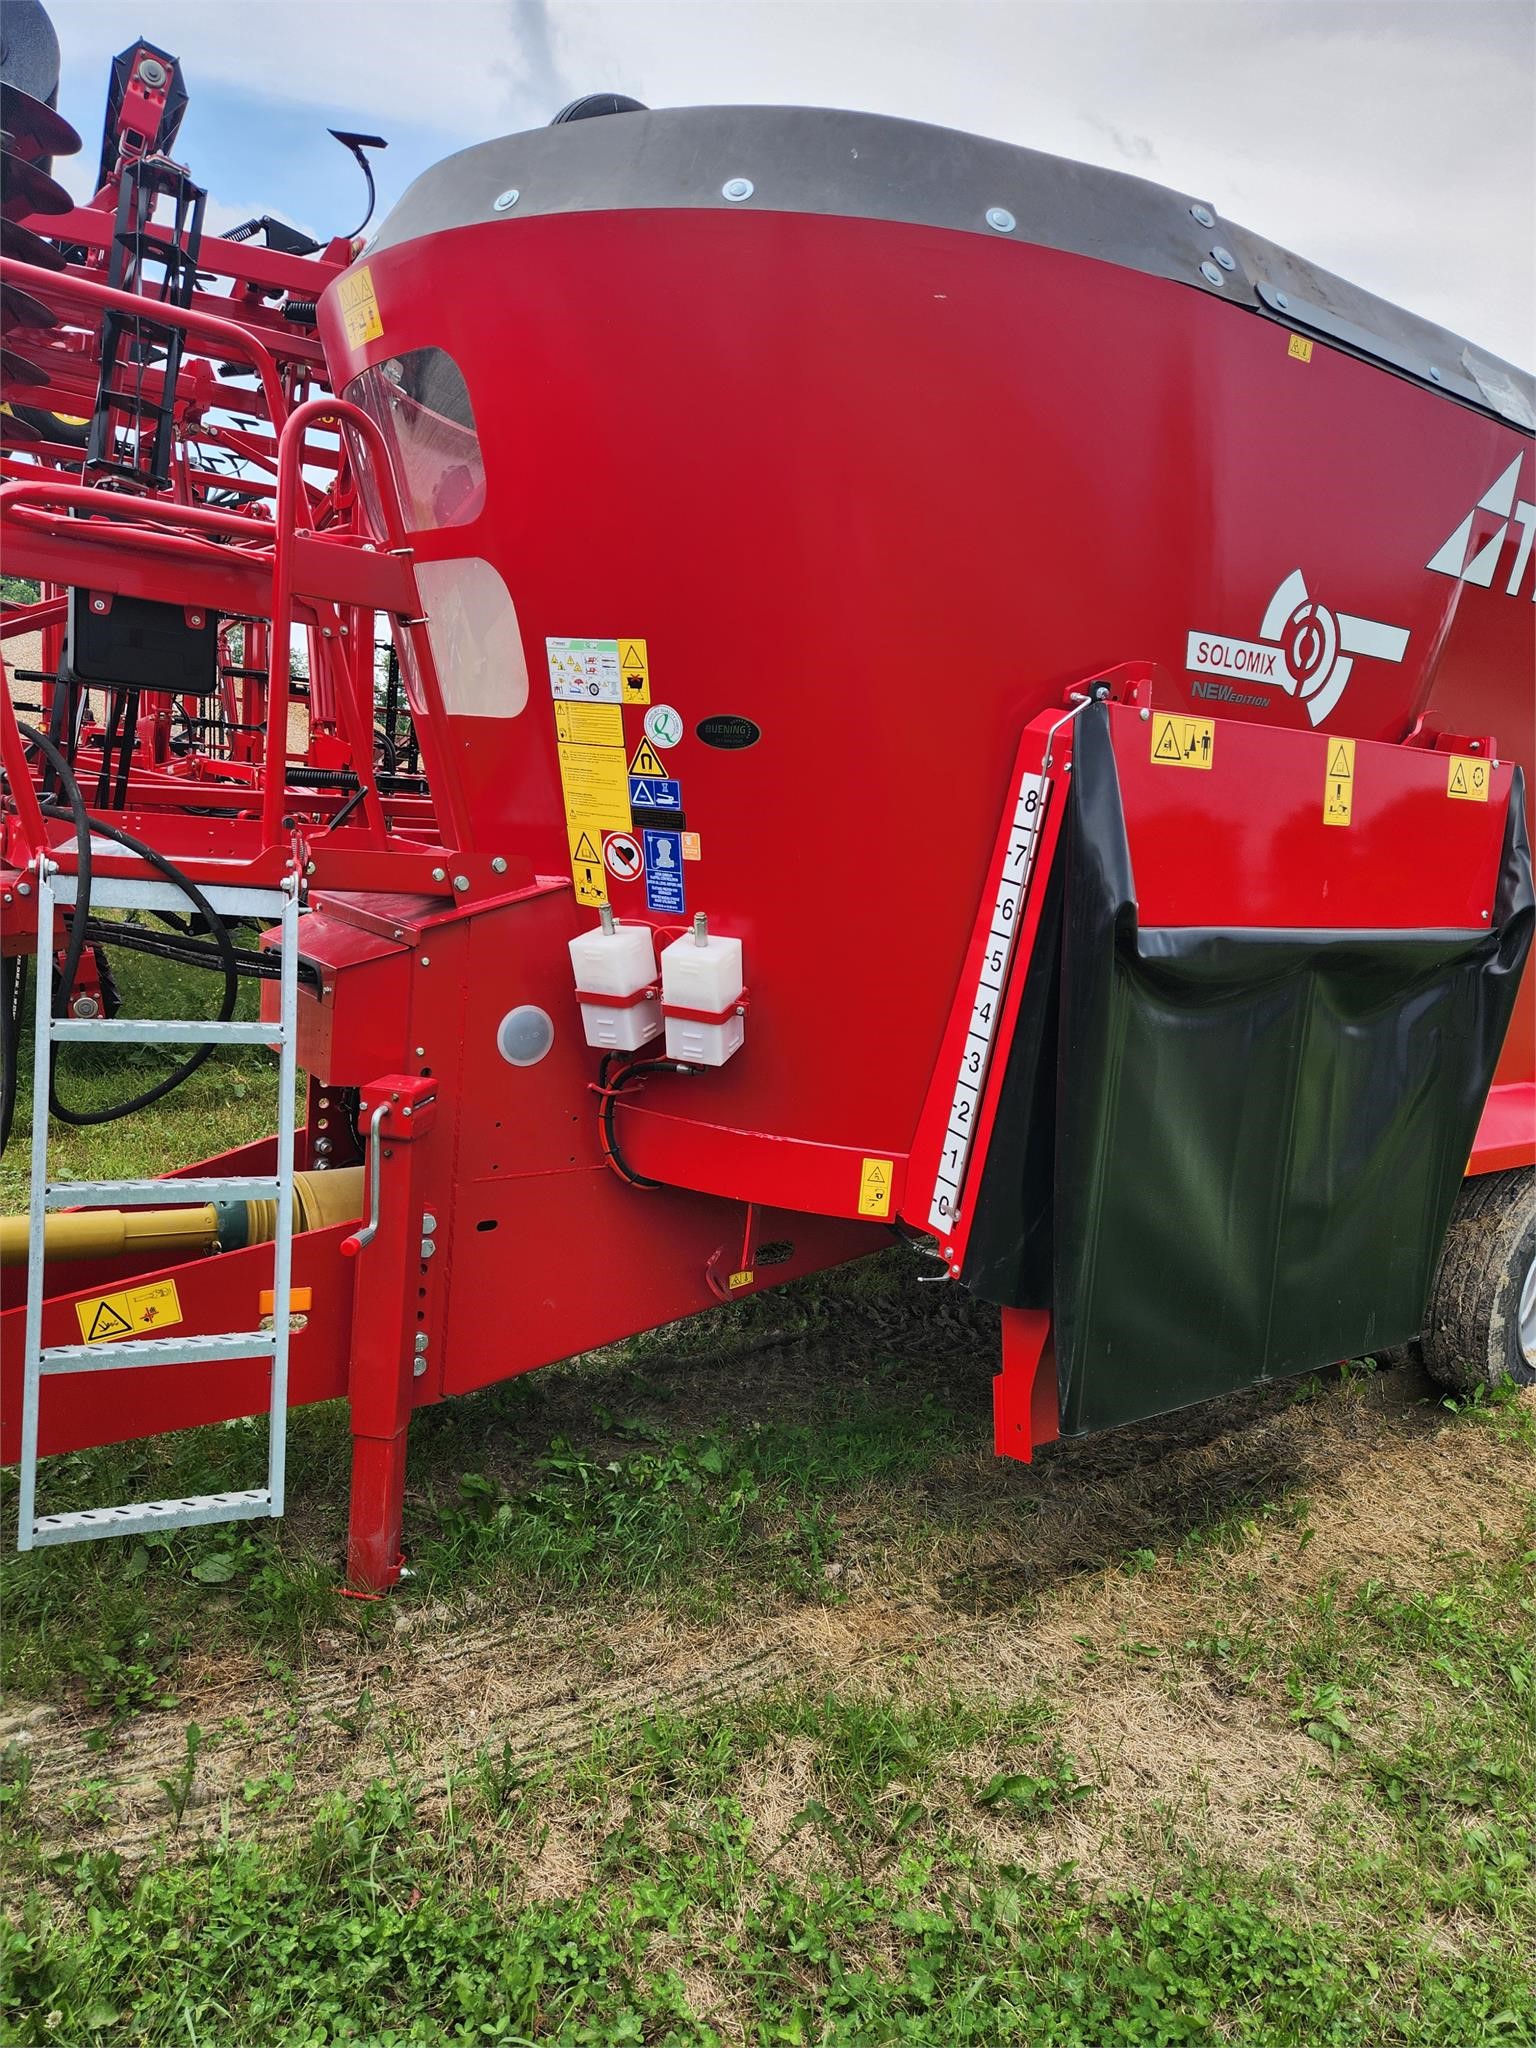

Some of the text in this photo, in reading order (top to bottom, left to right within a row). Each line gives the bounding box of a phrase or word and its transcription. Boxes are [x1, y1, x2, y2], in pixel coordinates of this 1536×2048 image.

[1197, 641, 1277, 676] SOLOMIX
[704, 723, 746, 735] BUENING
[1025, 790, 1038, 812] 8
[1015, 844, 1028, 866] 7
[1002, 898, 1015, 921] 6
[990, 950, 1003, 972] 5
[979, 1002, 992, 1024] 4
[968, 1051, 981, 1073] 3
[957, 1100, 970, 1123] 2
[950, 1148, 958, 1169] 1
[938, 1195, 950, 1217] 0
